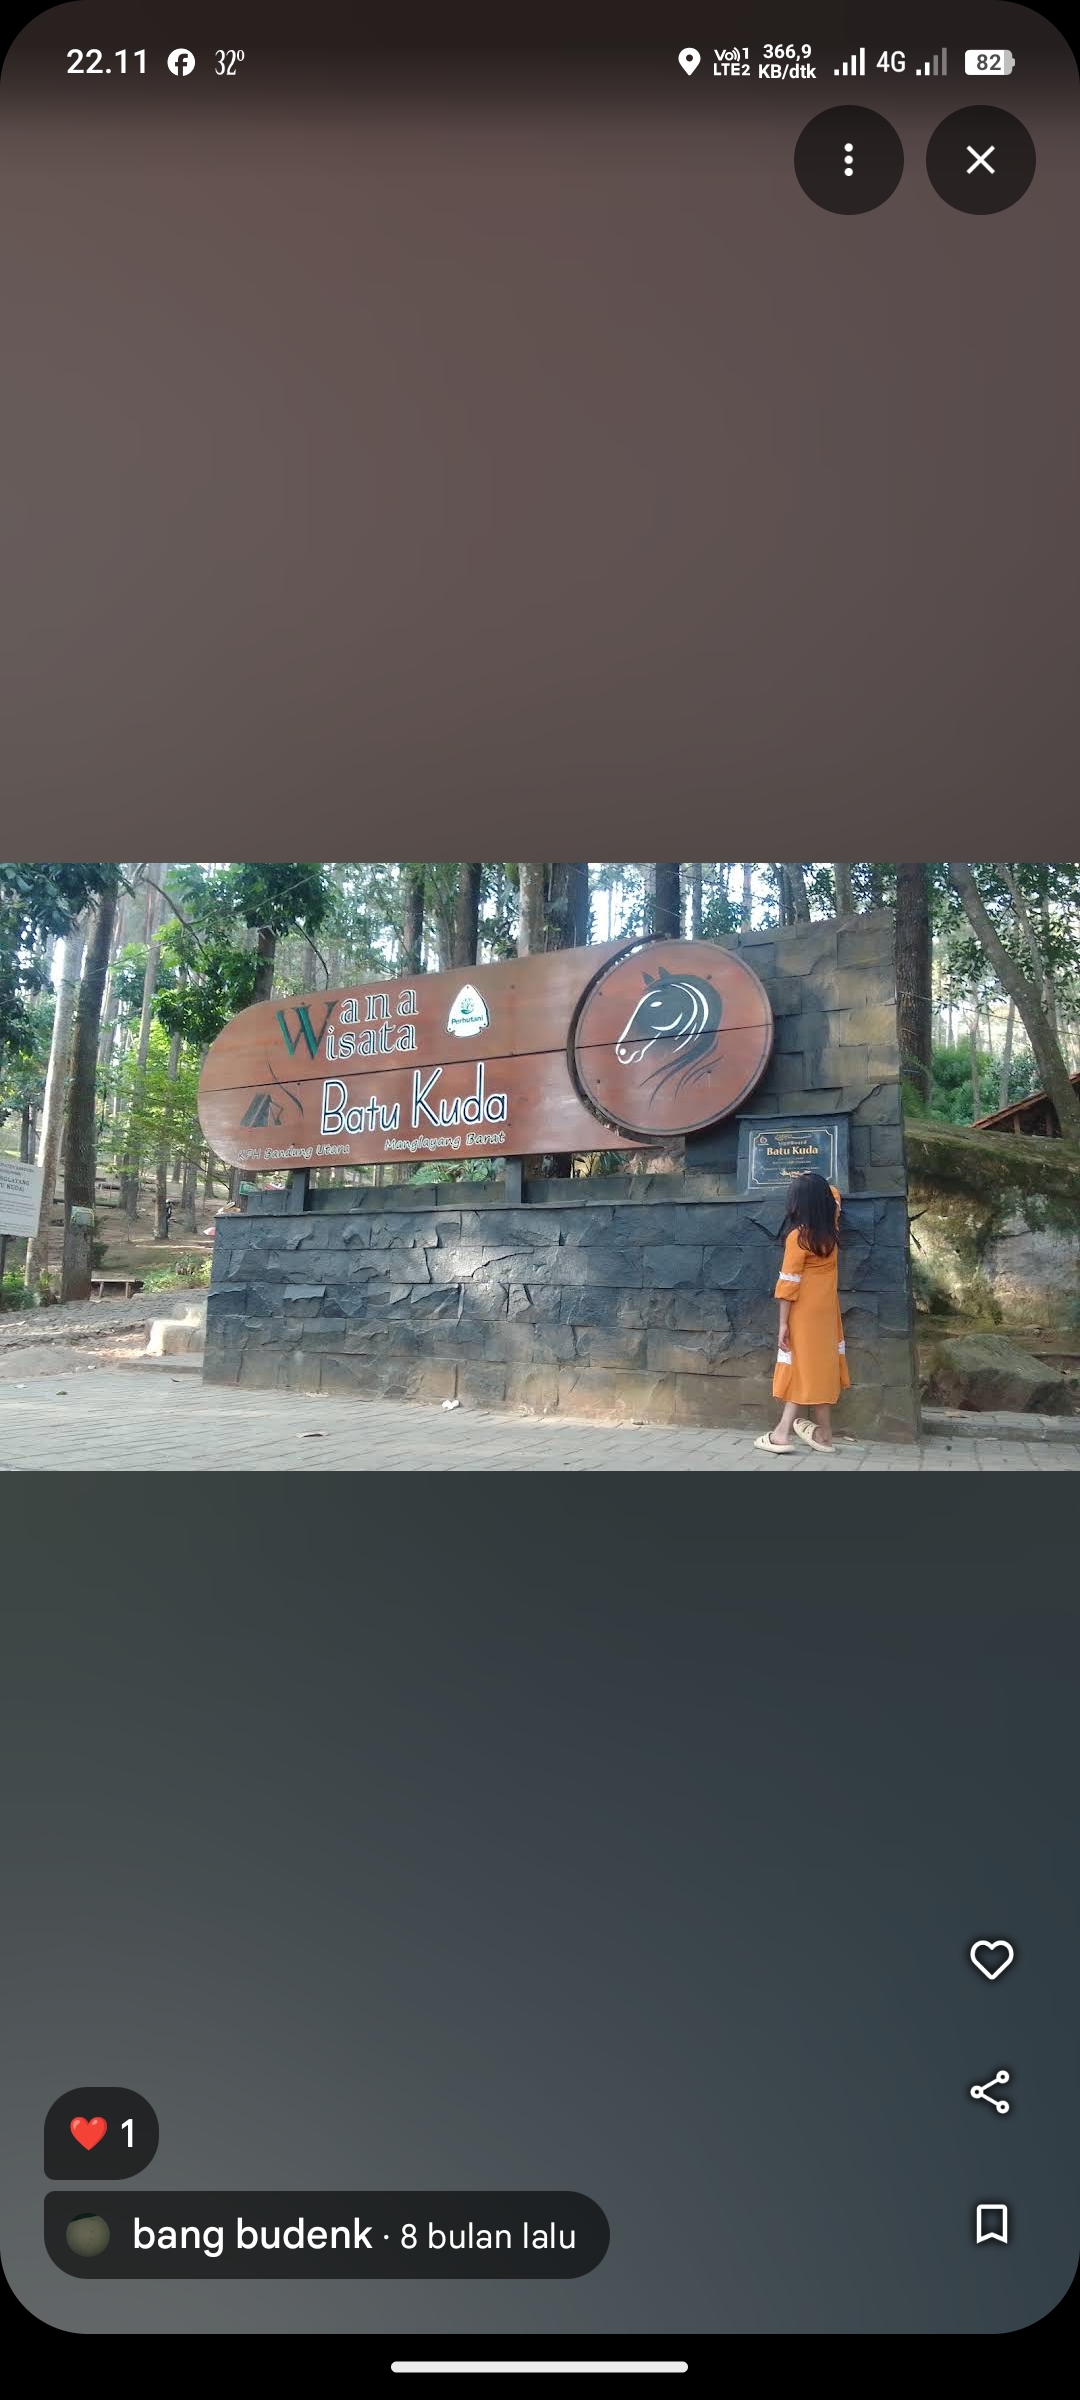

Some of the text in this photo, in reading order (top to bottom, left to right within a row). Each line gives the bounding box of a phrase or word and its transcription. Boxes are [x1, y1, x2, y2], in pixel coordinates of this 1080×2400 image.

[451, 1015, 484, 1025] Perhutani
[320, 1061, 508, 1136] Batu Kuda
[384, 1130, 506, 1153] Manglayang Barat
[263, 1146, 314, 1160] Bandung
[315, 1143, 351, 1156] Utara
[766, 1145, 819, 1156] Batu Kuda
